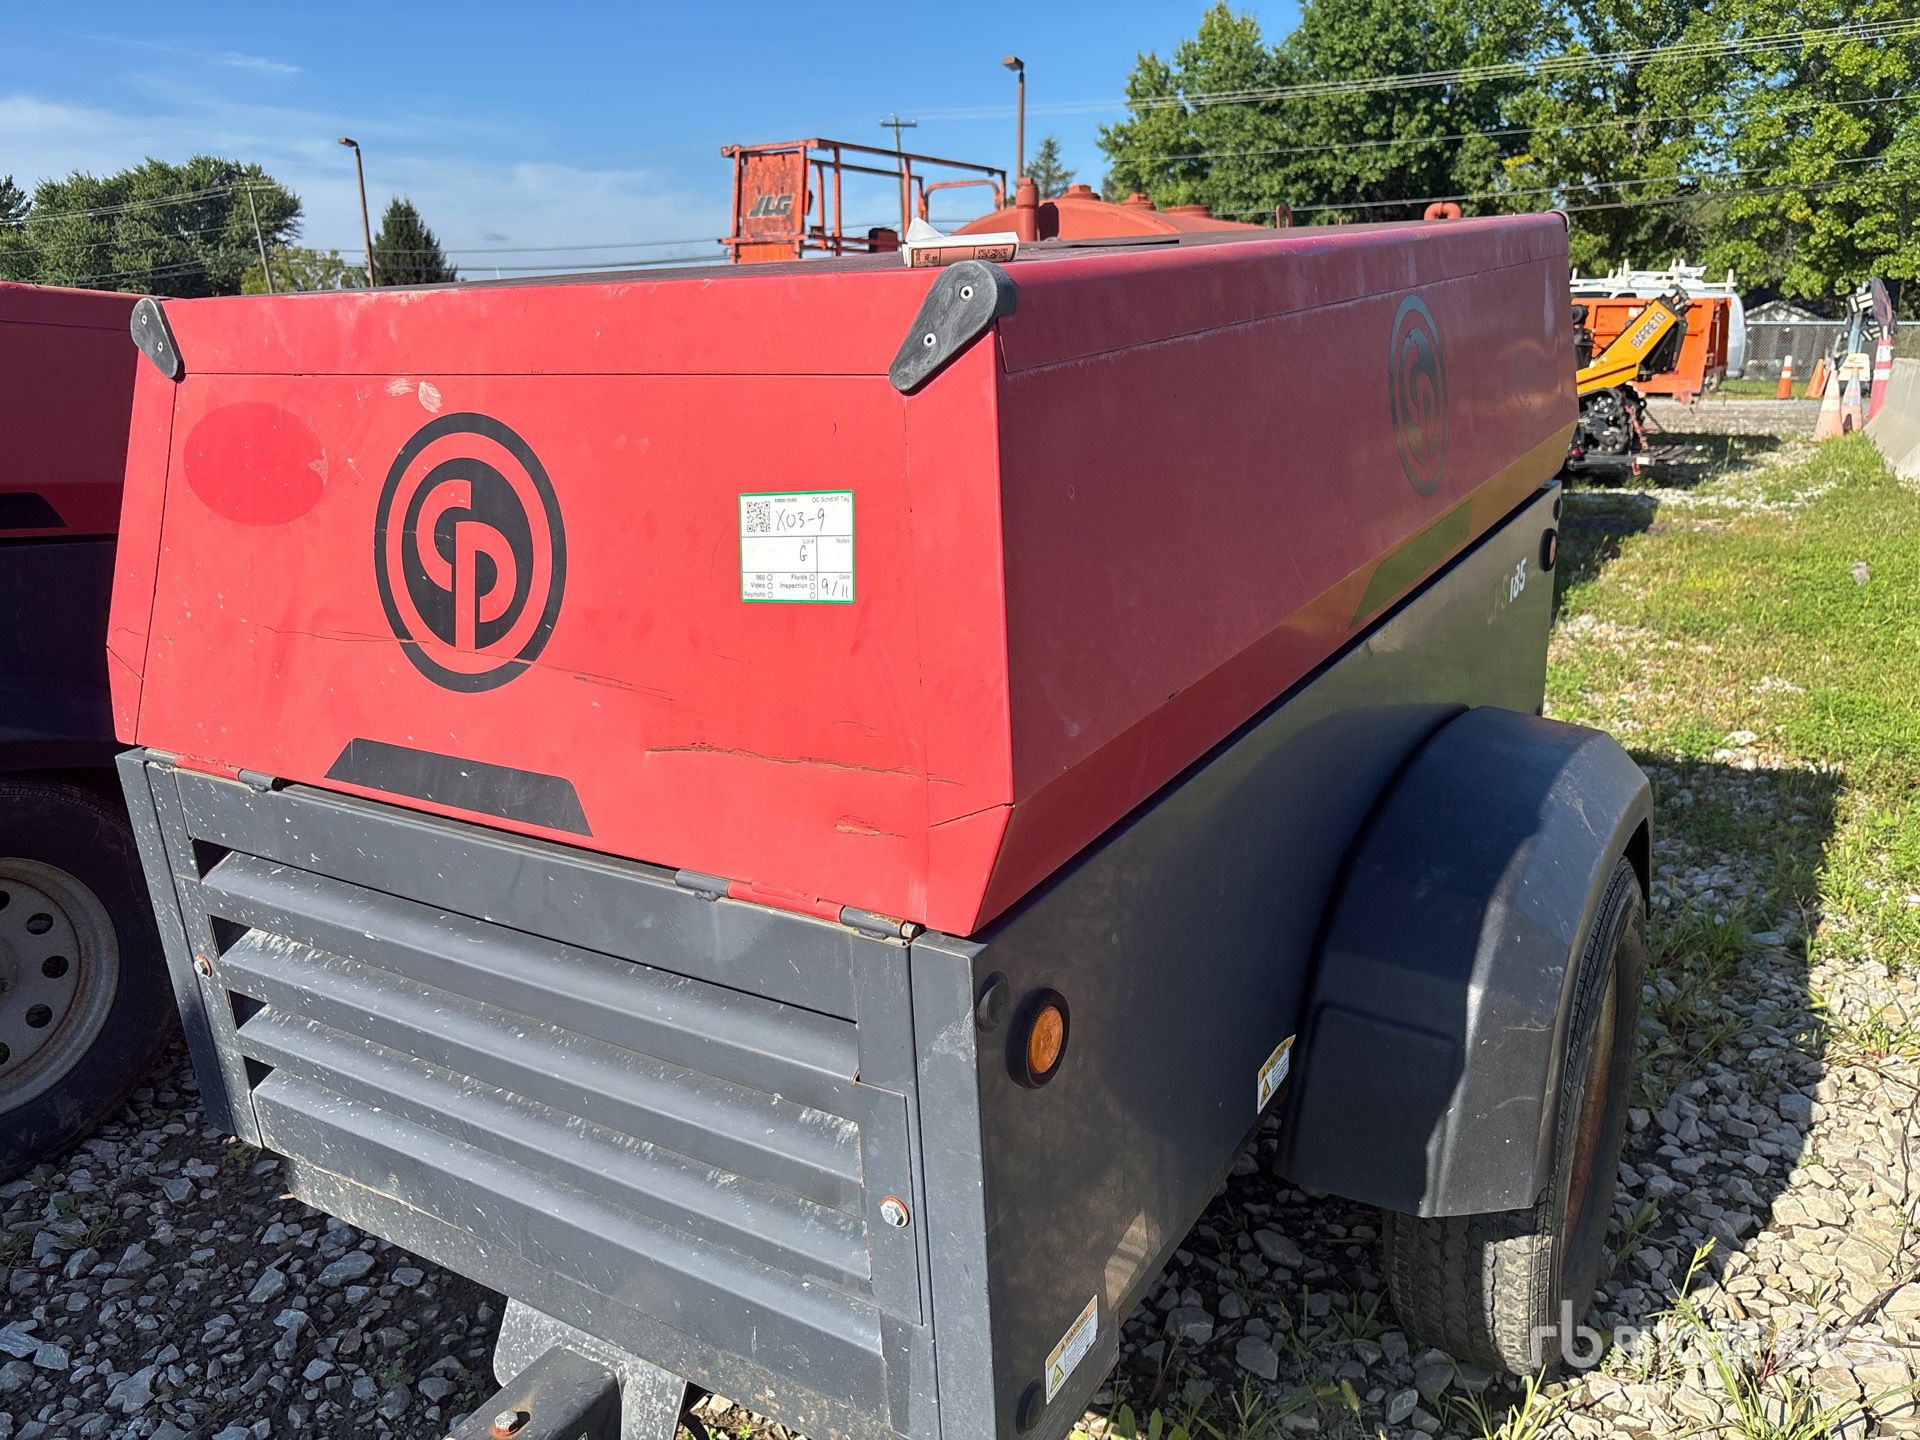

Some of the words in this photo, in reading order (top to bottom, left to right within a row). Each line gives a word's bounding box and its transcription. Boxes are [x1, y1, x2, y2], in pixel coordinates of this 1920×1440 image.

[750, 194, 794, 218] JLG
[1629, 310, 1667, 349] BARRETO
[744, 591, 766, 599] Rephoto
